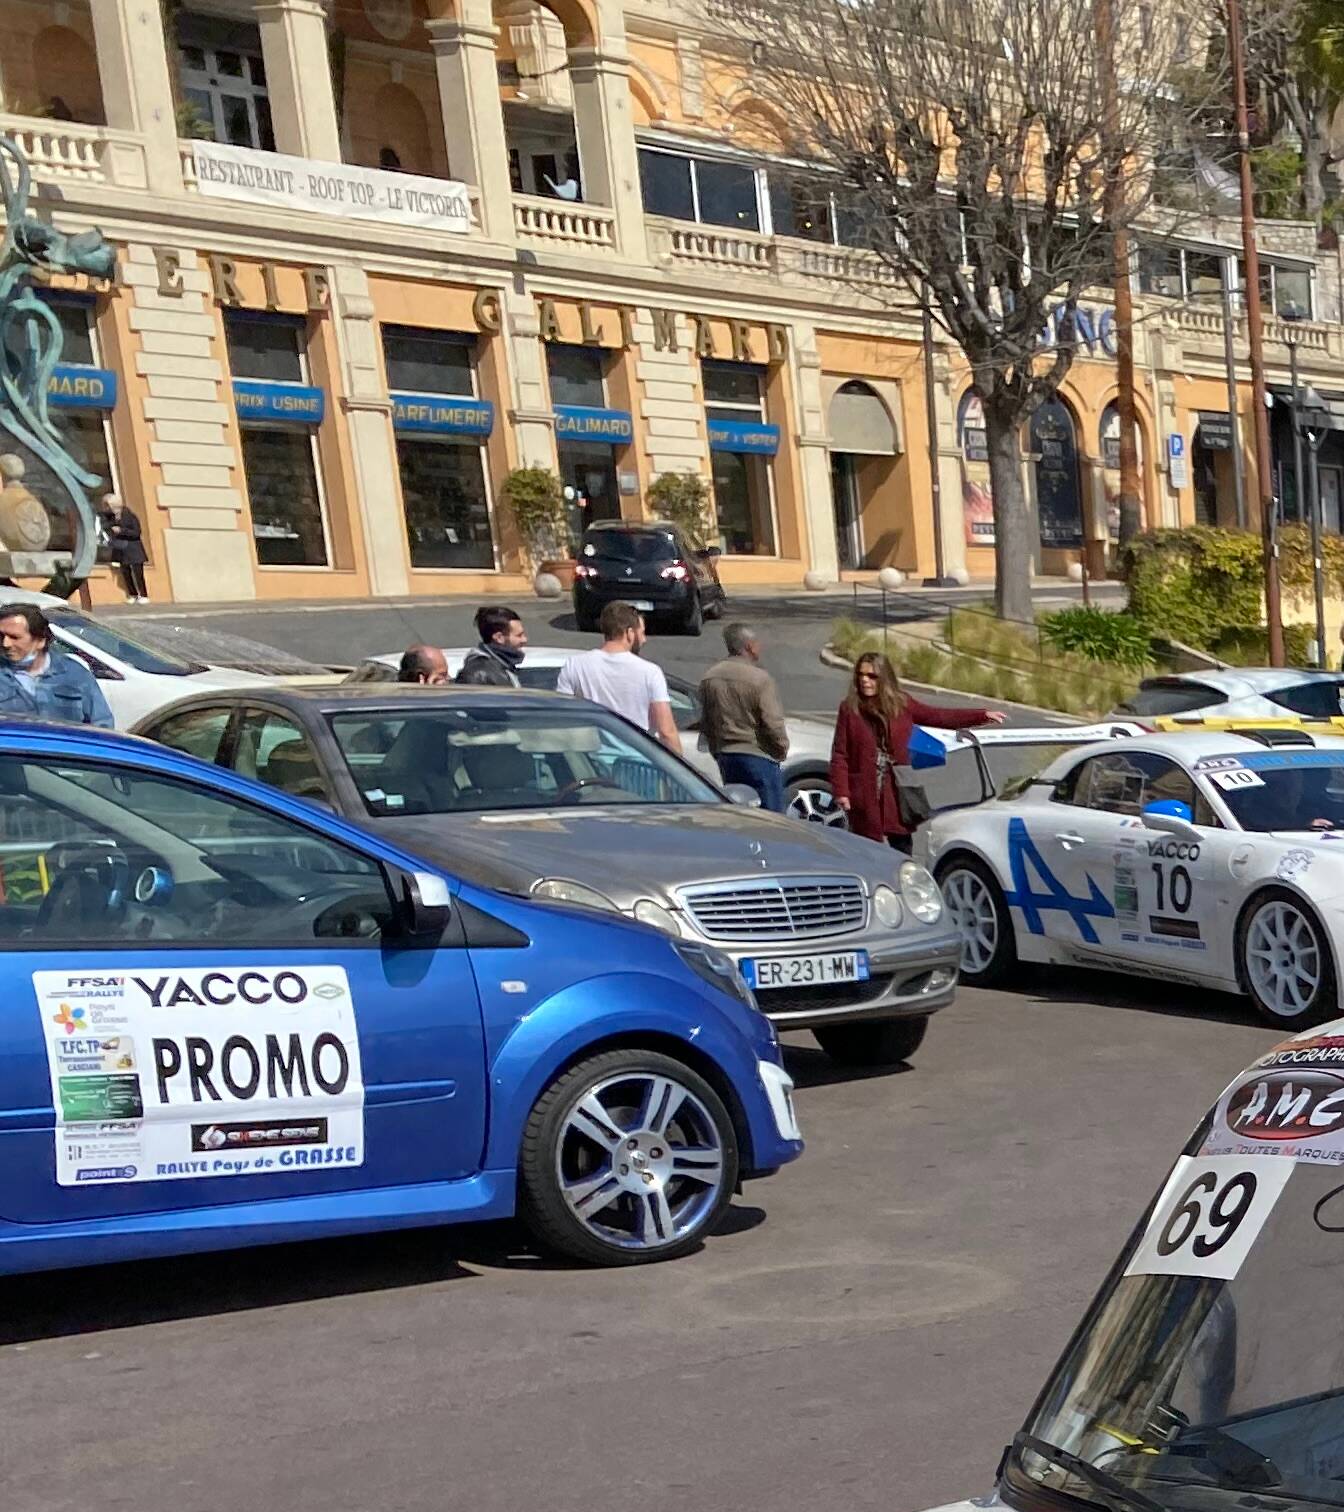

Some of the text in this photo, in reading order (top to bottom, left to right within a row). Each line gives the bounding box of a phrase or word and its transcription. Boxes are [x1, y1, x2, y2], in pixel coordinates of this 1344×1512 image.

[199, 159, 295, 194] RESTAURANT
[309, 174, 345, 201] ROOF
[349, 182, 375, 206] TOP
[387, 187, 404, 211] LE
[405, 190, 468, 218] VICTORIA
[473, 288, 786, 363] GALIMARD
[272, 396, 320, 412] USINE
[556, 414, 631, 436] GALIMARD
[1223, 771, 1257, 786] 10
[1147, 840, 1201, 862] YACCO
[1151, 862, 1193, 914] 10
[757, 955, 856, 985] ER-231-MW
[130, 971, 309, 1008] YACCO
[152, 1031, 349, 1104] PROMO
[156, 1146, 357, 1176] RALLYE Pays de GRASSE
[1157, 1171, 1258, 1258] 69
